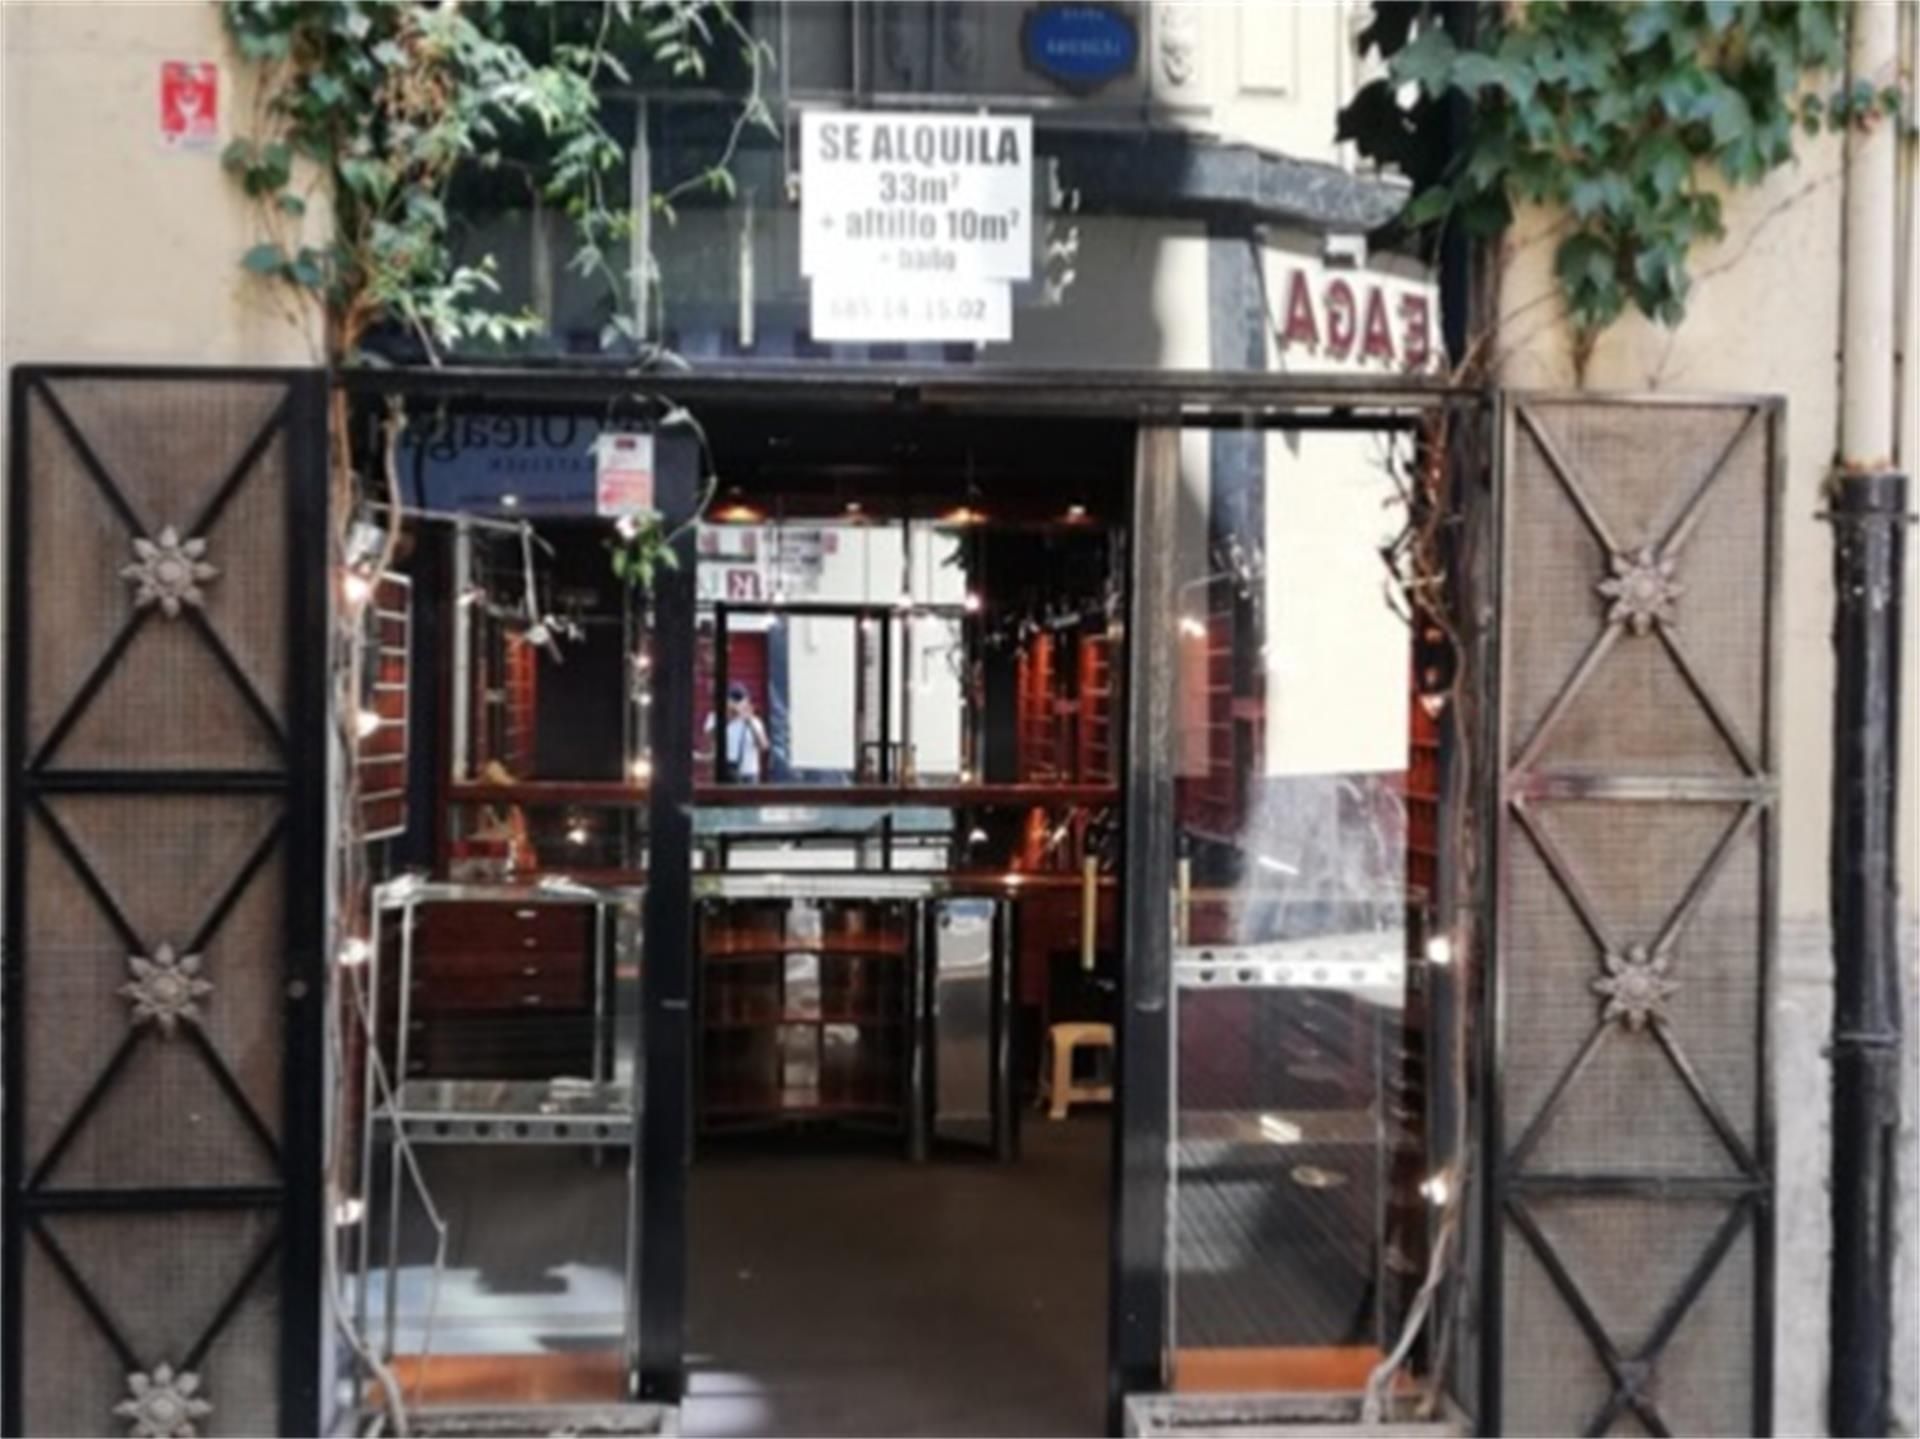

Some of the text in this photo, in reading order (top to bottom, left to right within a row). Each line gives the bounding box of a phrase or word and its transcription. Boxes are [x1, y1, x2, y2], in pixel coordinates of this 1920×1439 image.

[819, 122, 1020, 166] SE ALQUILA
[846, 208, 937, 240] altillo
